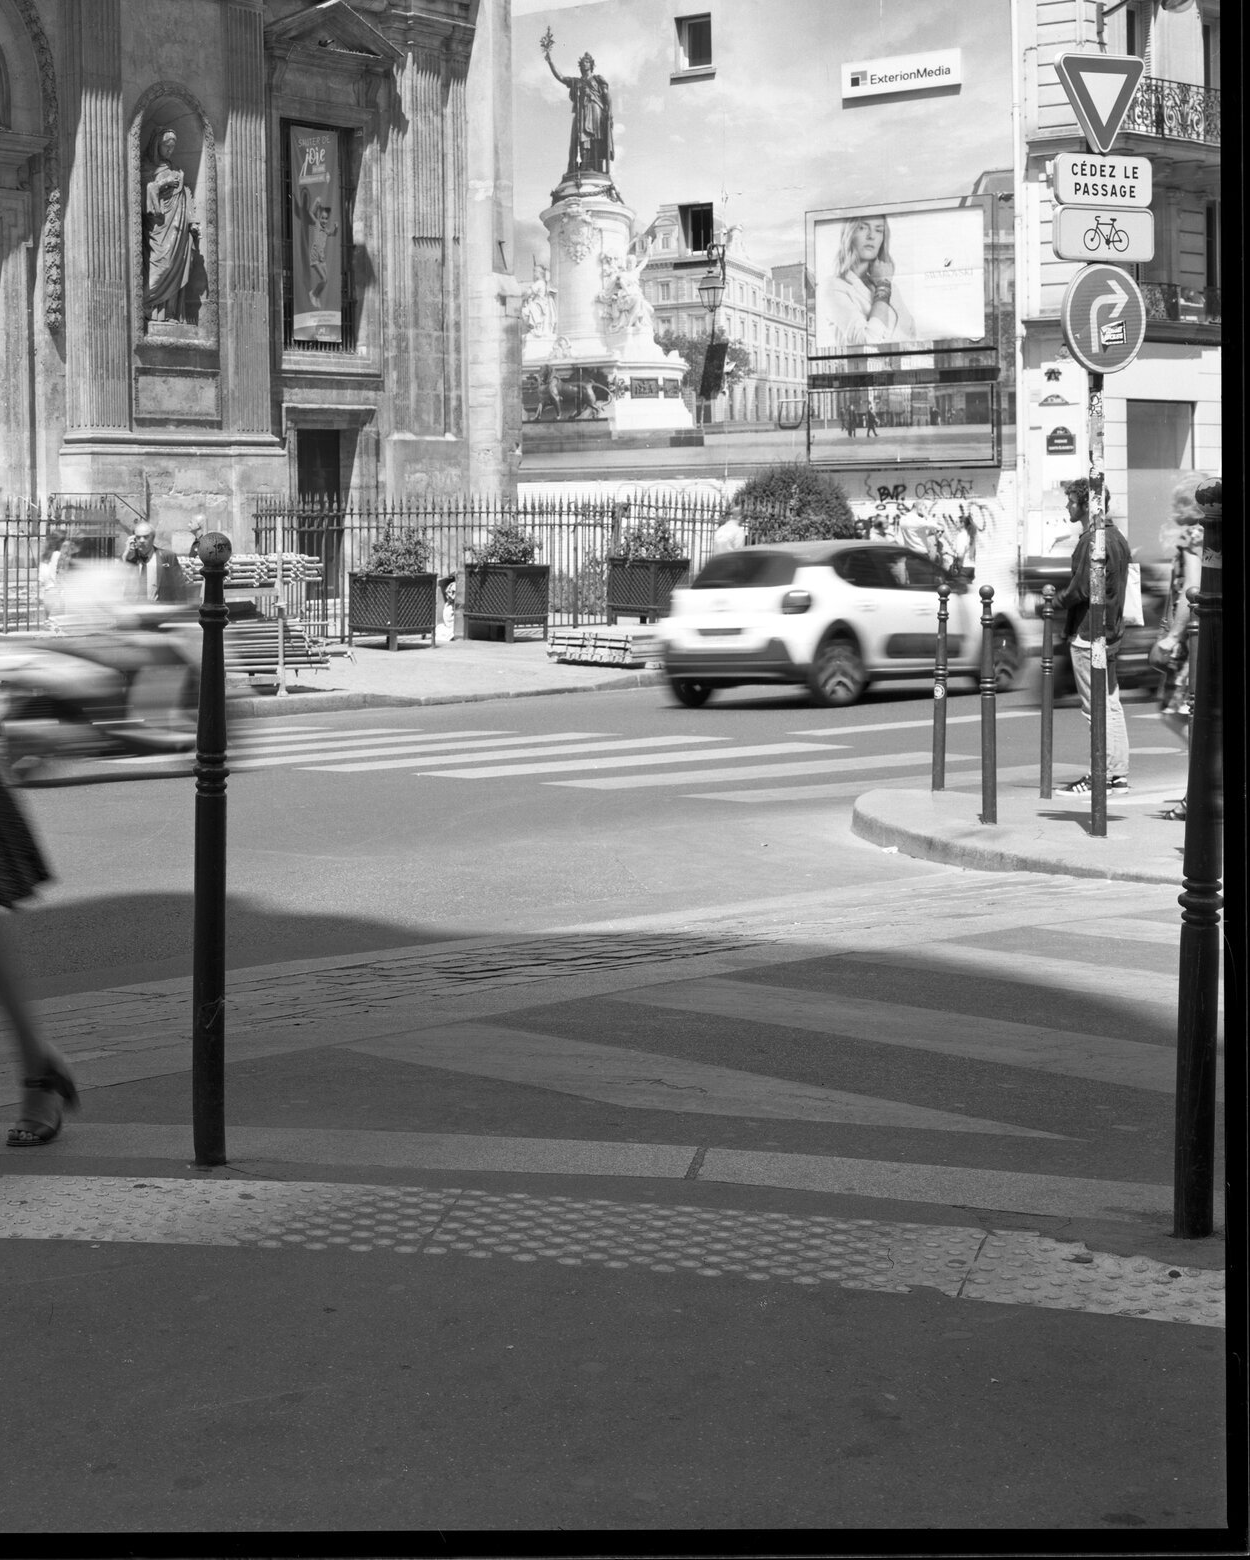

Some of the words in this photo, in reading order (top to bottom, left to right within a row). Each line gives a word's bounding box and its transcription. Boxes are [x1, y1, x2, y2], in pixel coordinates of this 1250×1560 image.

[870, 66, 951, 85] ExterionMedia
[1071, 160, 1116, 178] CÉDEZ
[1124, 166, 1139, 180] LE
[1074, 182, 1136, 199] PASSAGE
